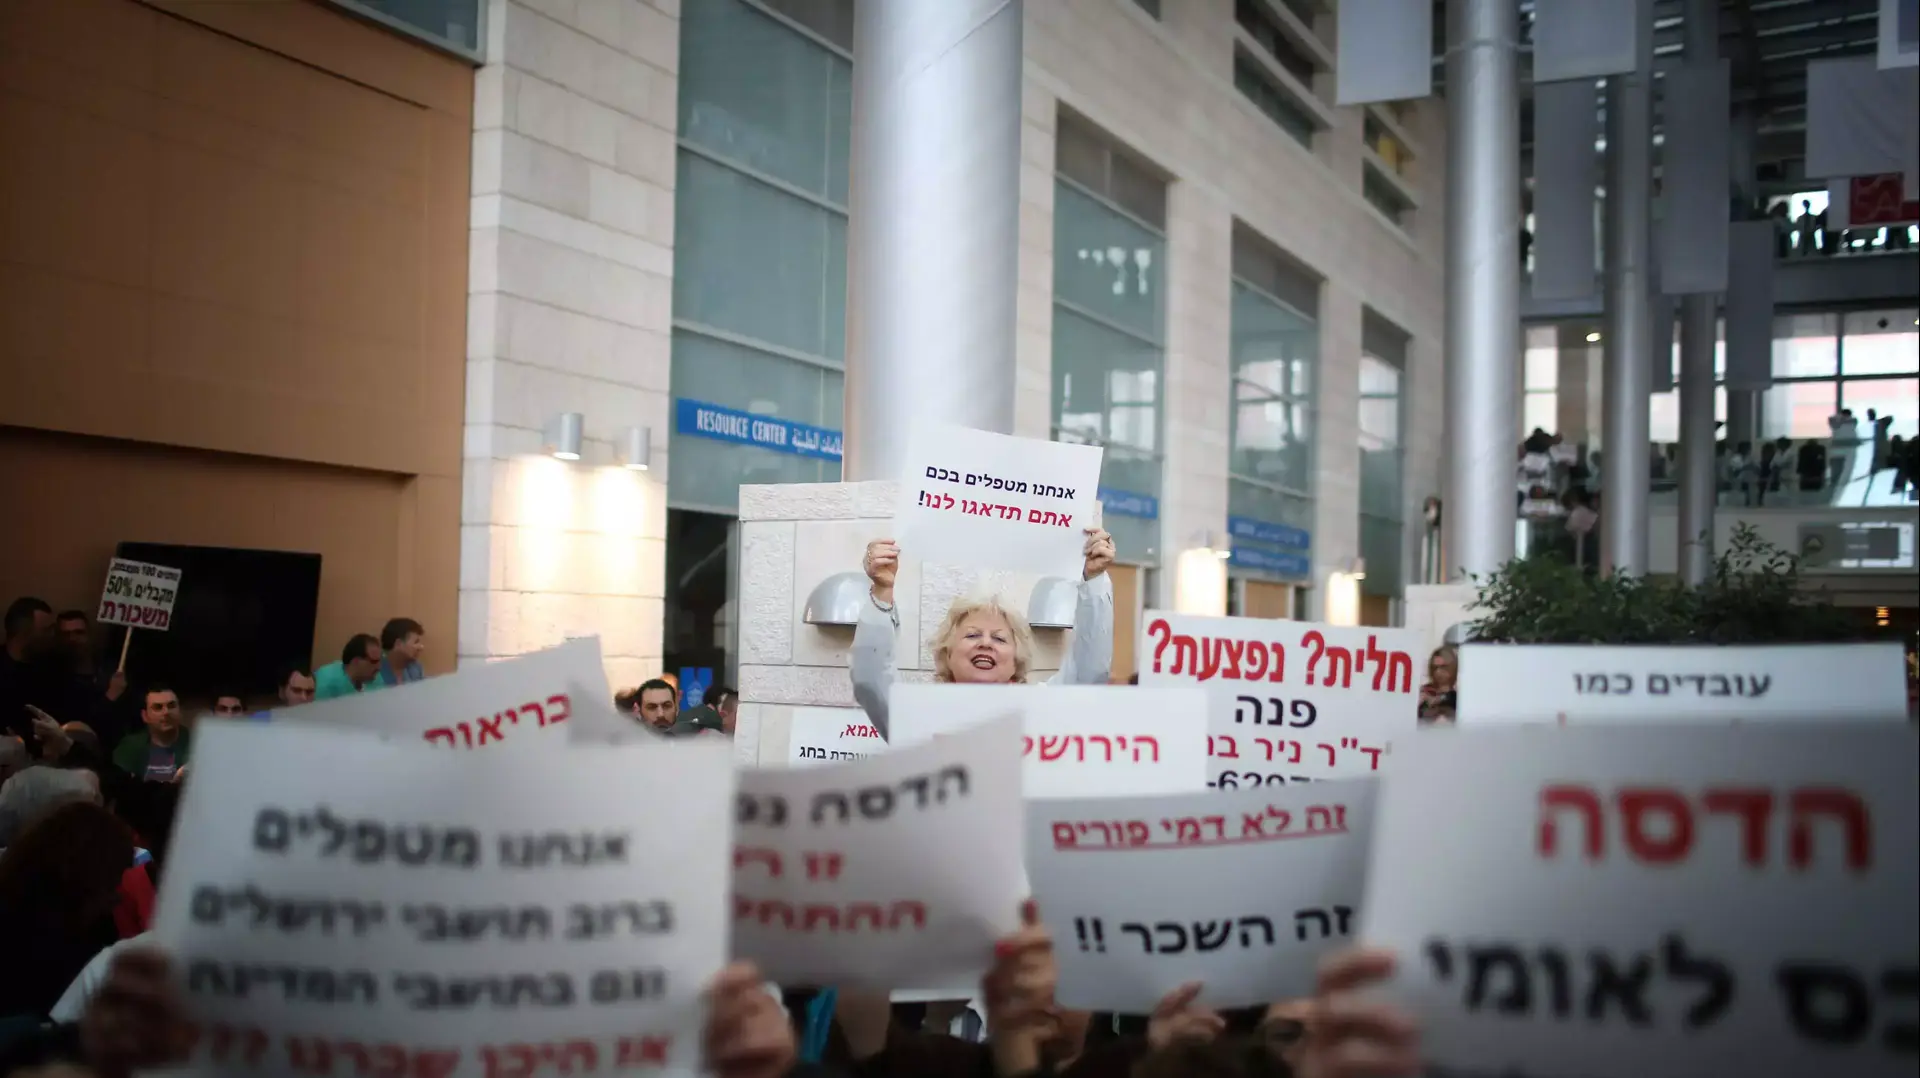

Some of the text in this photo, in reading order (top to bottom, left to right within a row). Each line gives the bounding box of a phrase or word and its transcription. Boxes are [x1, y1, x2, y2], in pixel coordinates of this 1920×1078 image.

[697, 408, 787, 445] RESOURCE CENTER
[926, 466, 1076, 499] אנחנו מטפלים בכם
[918, 490, 1072, 527] אתם תדאגו לנו!
[135, 582, 173, 604] מקבלים
[100, 601, 169, 627] משכורת
[1148, 619, 1412, 693] חלית? נפצעת?
[1573, 672, 1773, 697] עובדים כמו
[1235, 695, 1318, 728] פנה
[839, 724, 879, 739] אמא,
[799, 746, 827, 759] בחג
[1254, 738, 1302, 763] ניר
[811, 763, 970, 827] הדסה
[254, 807, 631, 870] אנחנו מטפלים
[1052, 804, 1347, 848] זה לא דמי פורים
[1537, 782, 1874, 872] הדסה
[190, 882, 677, 943] ברוב תושבי ירושלים
[1074, 905, 1354, 955] זה השכר !!
[1425, 930, 1735, 1028] לאומי
